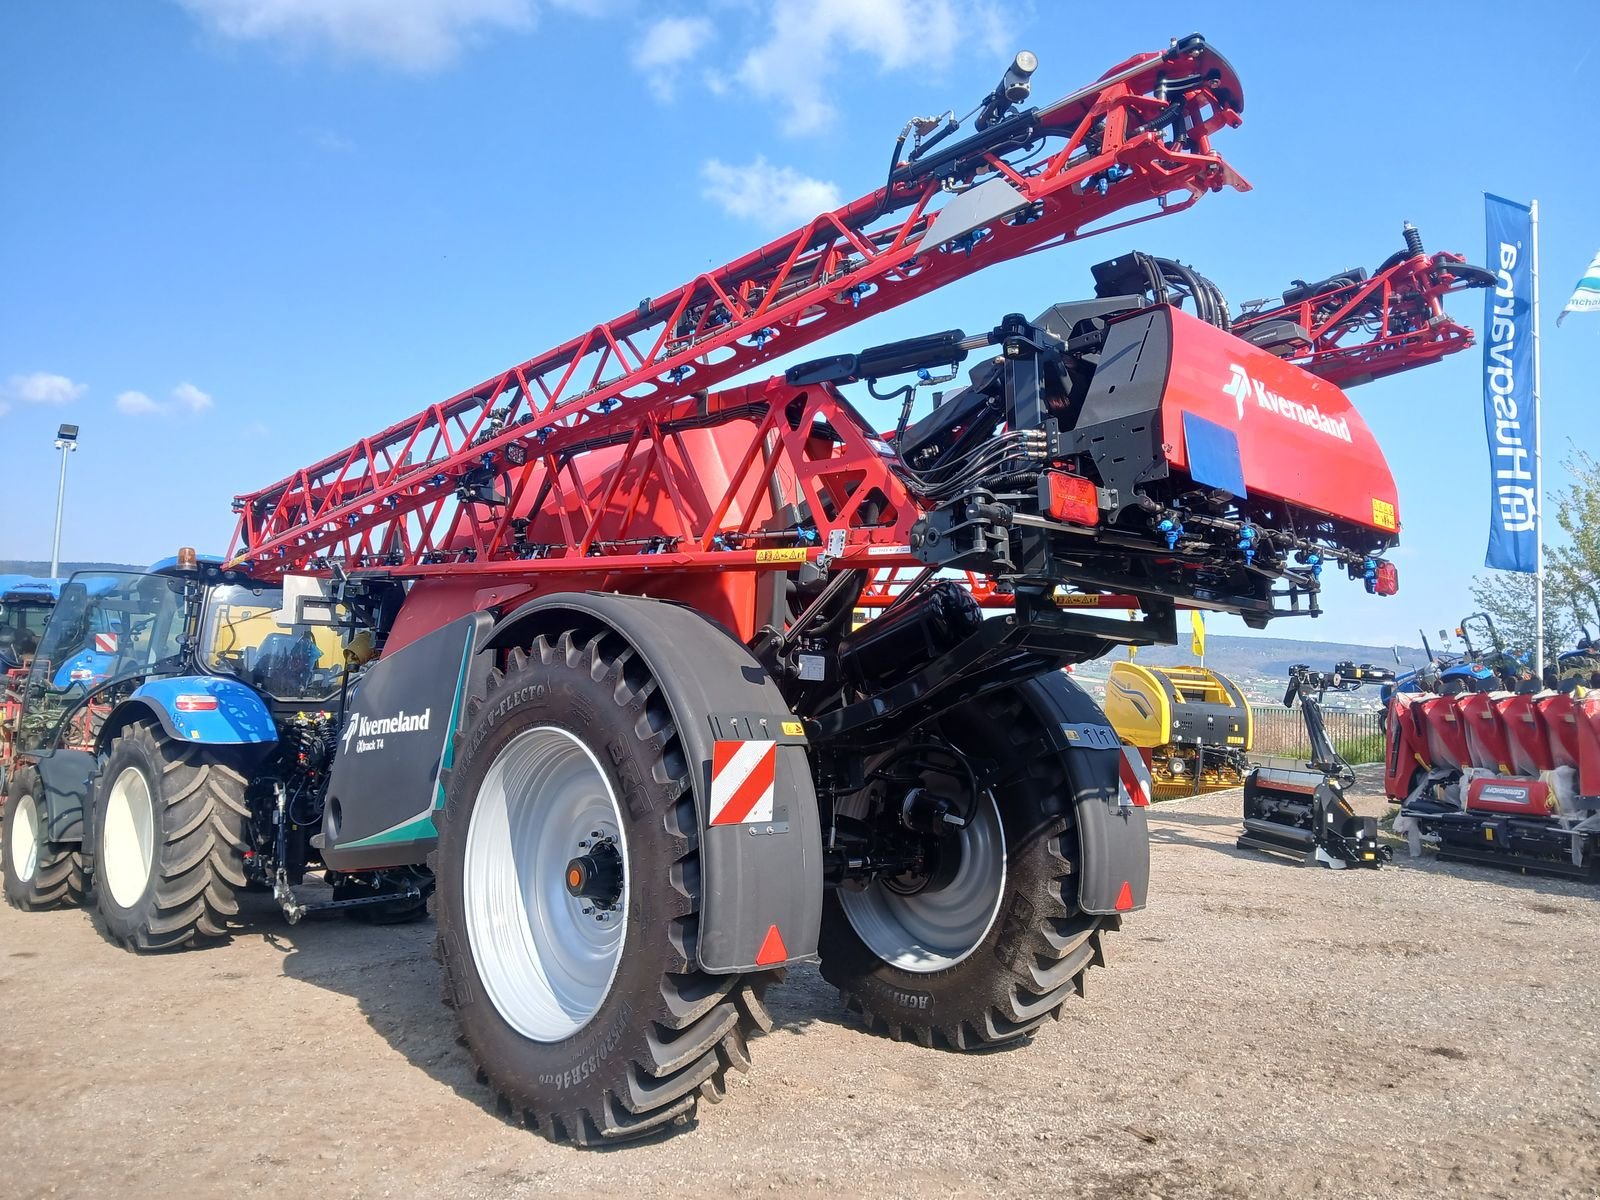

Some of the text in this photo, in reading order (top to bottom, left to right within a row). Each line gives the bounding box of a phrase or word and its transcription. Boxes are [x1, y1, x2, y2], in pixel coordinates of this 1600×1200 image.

[1251, 378, 1353, 443] Kverneland
[358, 707, 431, 737] Kverneland
[488, 684, 545, 727] V-FLECTO
[376, 738, 384, 750] T4
